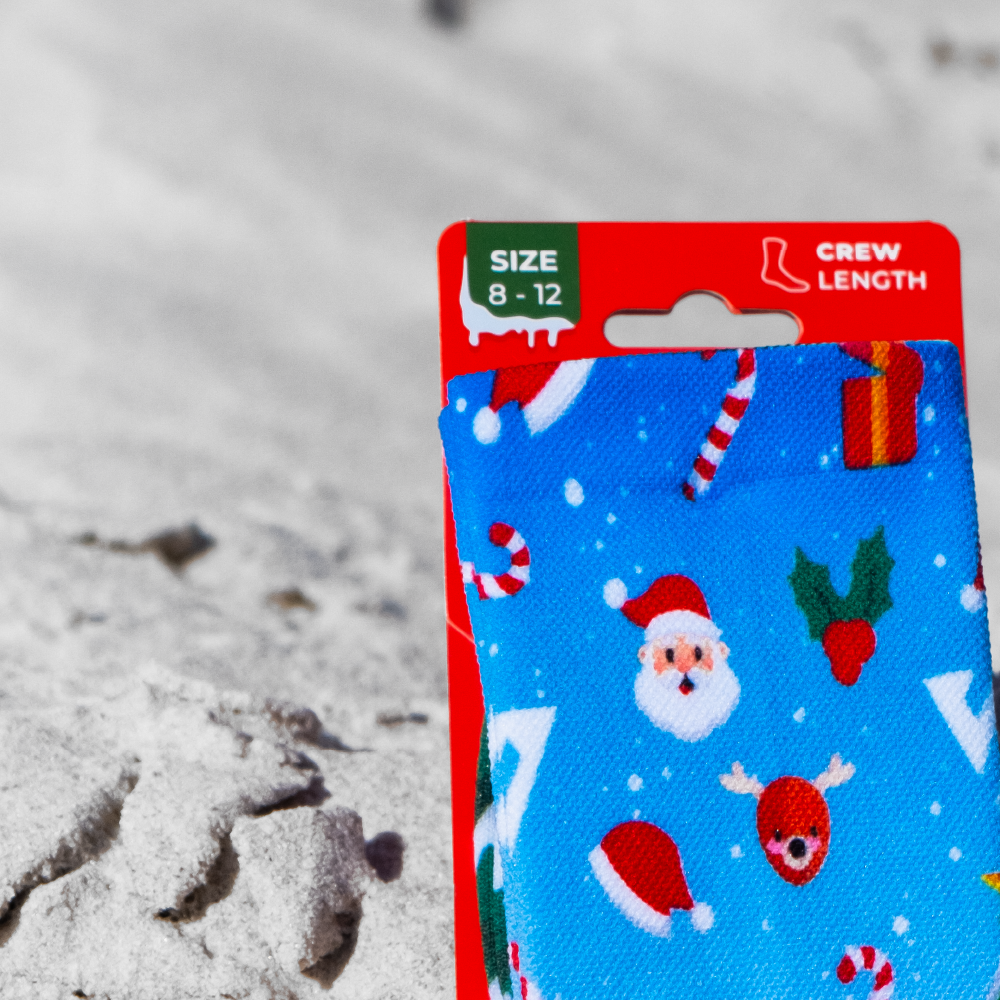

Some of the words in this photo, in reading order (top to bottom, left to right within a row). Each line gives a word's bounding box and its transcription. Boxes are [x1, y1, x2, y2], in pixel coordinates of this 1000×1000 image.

[490, 249, 559, 272] SIZE
[815, 242, 901, 262] CREW
[818, 269, 927, 291] LENGTH
[488, 283, 507, 305] 8
[533, 282, 563, 305] 12
